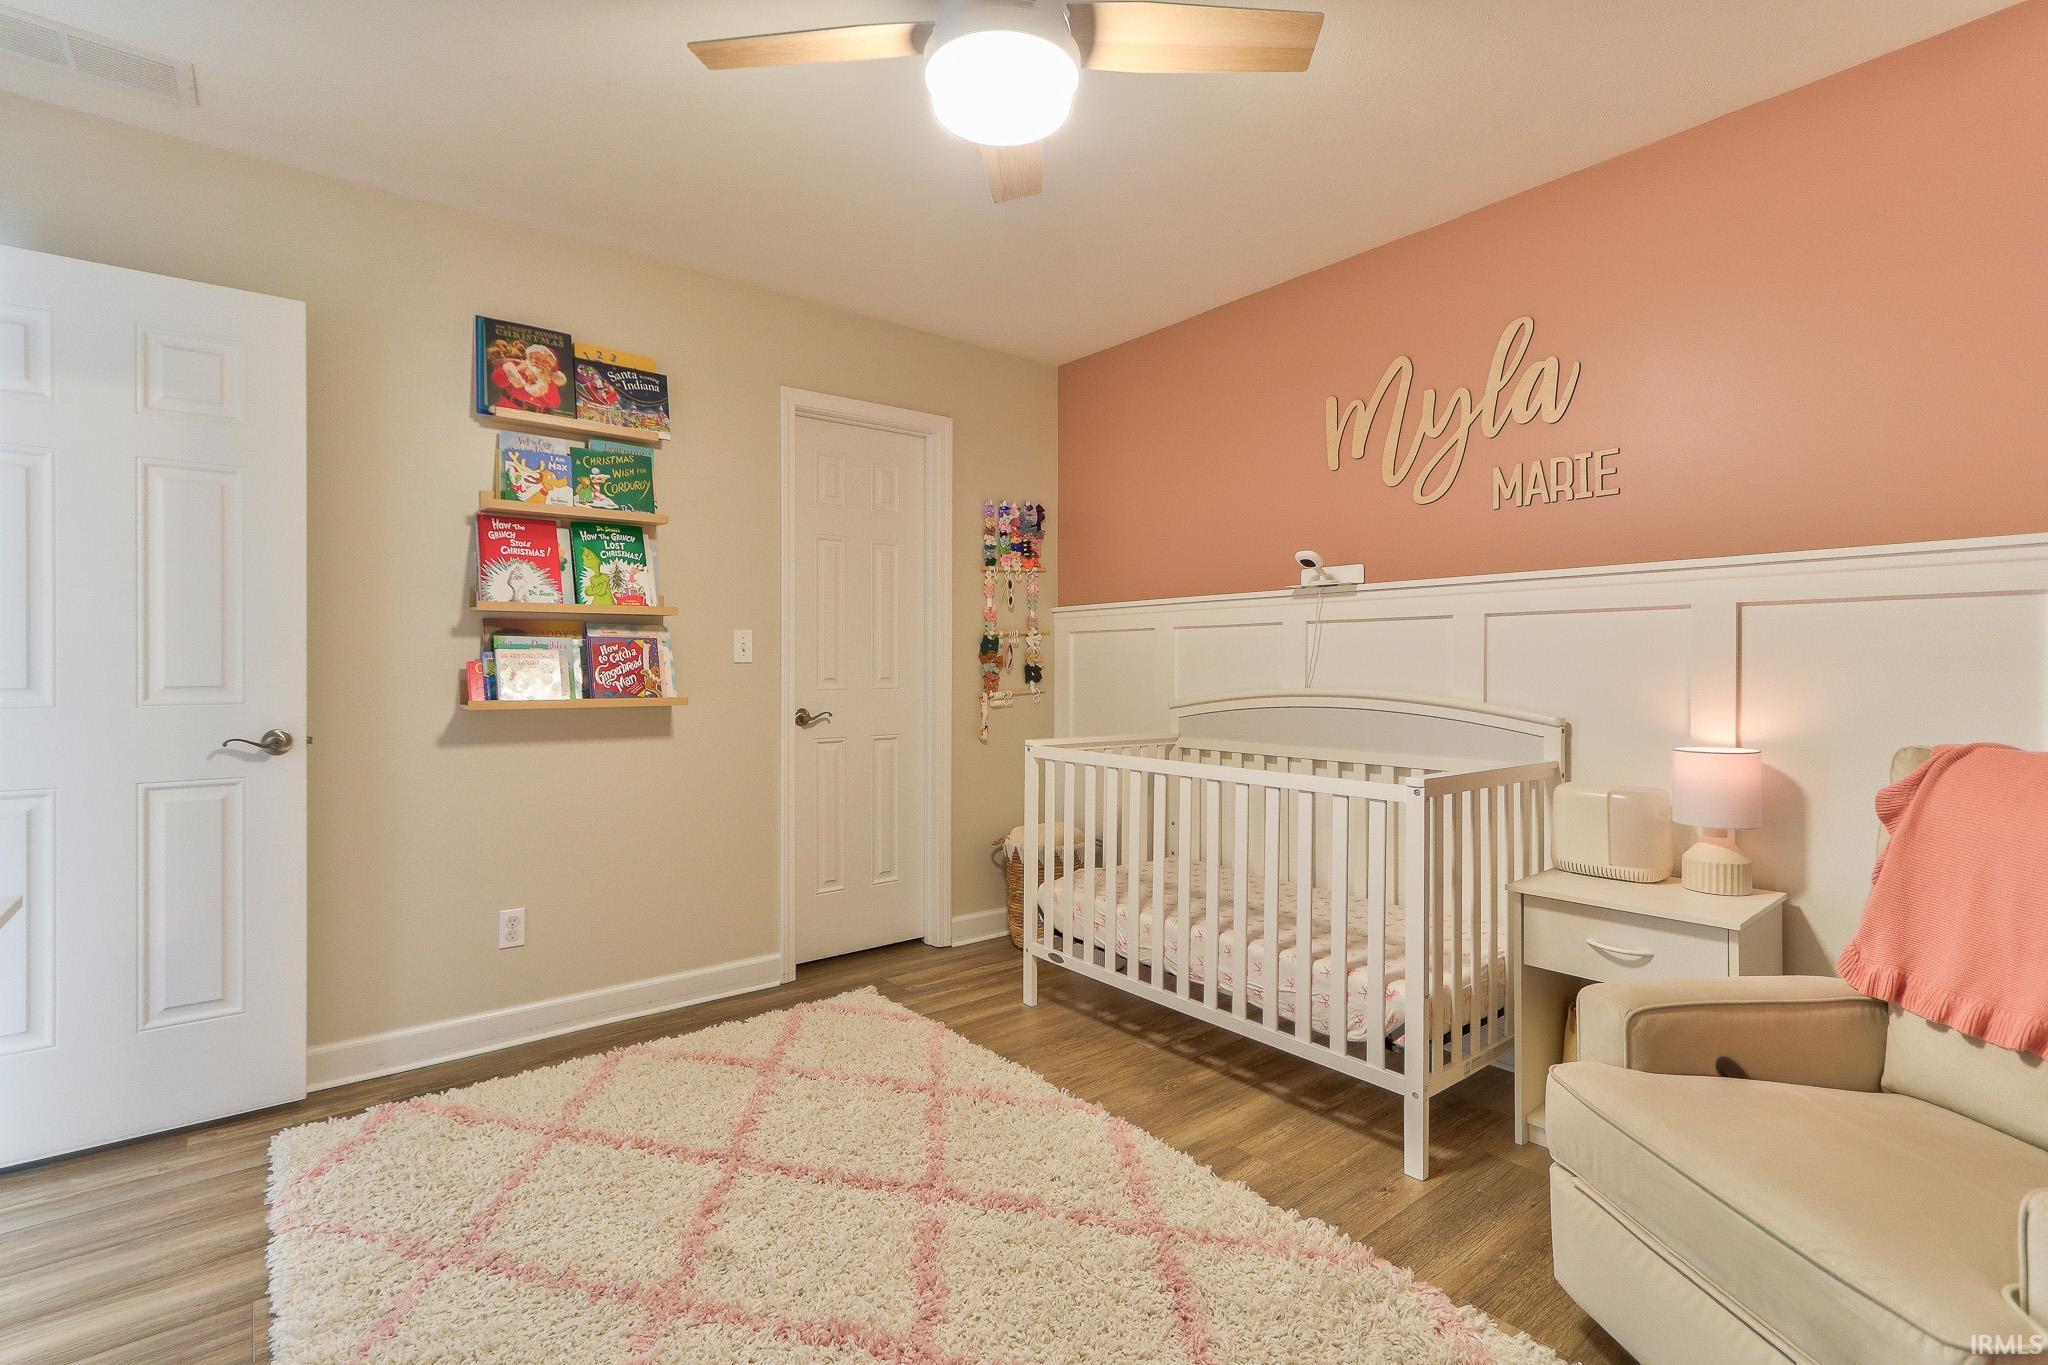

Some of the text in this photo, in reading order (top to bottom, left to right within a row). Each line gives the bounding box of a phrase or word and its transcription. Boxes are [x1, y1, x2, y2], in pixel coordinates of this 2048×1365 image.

[495, 328, 564, 348] CHRISTMAS
[596, 351, 603, 360] 2
[610, 353, 617, 362] 3
[607, 370, 638, 382] Santa
[622, 380, 660, 393] Indiana
[1326, 316, 1581, 505] Myla
[548, 460, 568, 472] Max
[582, 455, 635, 469] CHRISTMAS
[612, 468, 635, 479] WISH
[1493, 448, 1621, 510] MARIE
[604, 480, 651, 501] CORDUROY
[488, 530, 516, 540] GRINCH
[598, 533, 610, 541] The
[611, 532, 636, 543] GRINCH
[510, 539, 532, 548] STOLE
[604, 540, 626, 551] LOST
[600, 550, 643, 561] CHRISTMAS!
[598, 646, 638, 664] to Catch a
[600, 643, 619, 656] How
[595, 654, 643, 688] Gingerbread
[612, 674, 637, 693] Man
